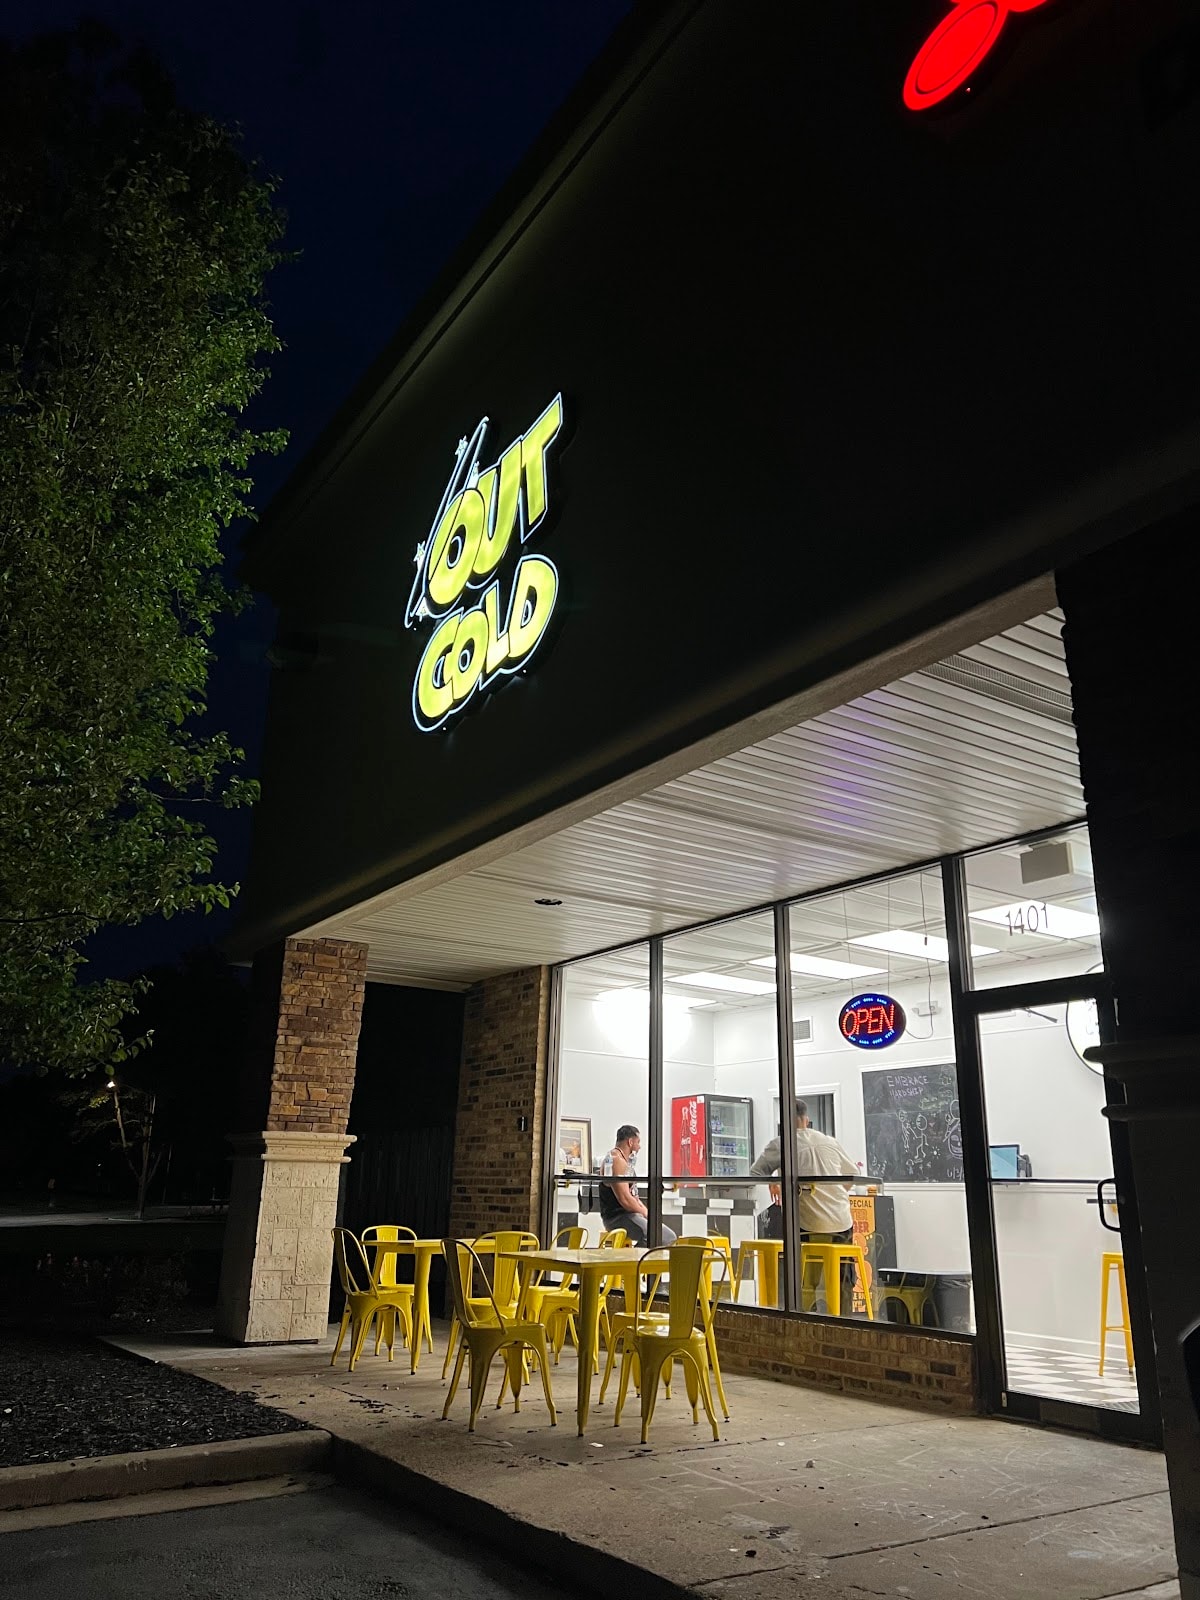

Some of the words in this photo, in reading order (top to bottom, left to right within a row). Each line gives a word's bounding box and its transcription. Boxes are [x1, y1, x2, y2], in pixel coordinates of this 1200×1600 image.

[425, 393, 562, 612] OUT
[415, 556, 558, 728] COLD
[1005, 902, 1048, 936] 1401
[842, 1004, 894, 1035] OPEN
[886, 1075, 929, 1087] EMBRACE
[849, 1199, 872, 1208] PECIAL
